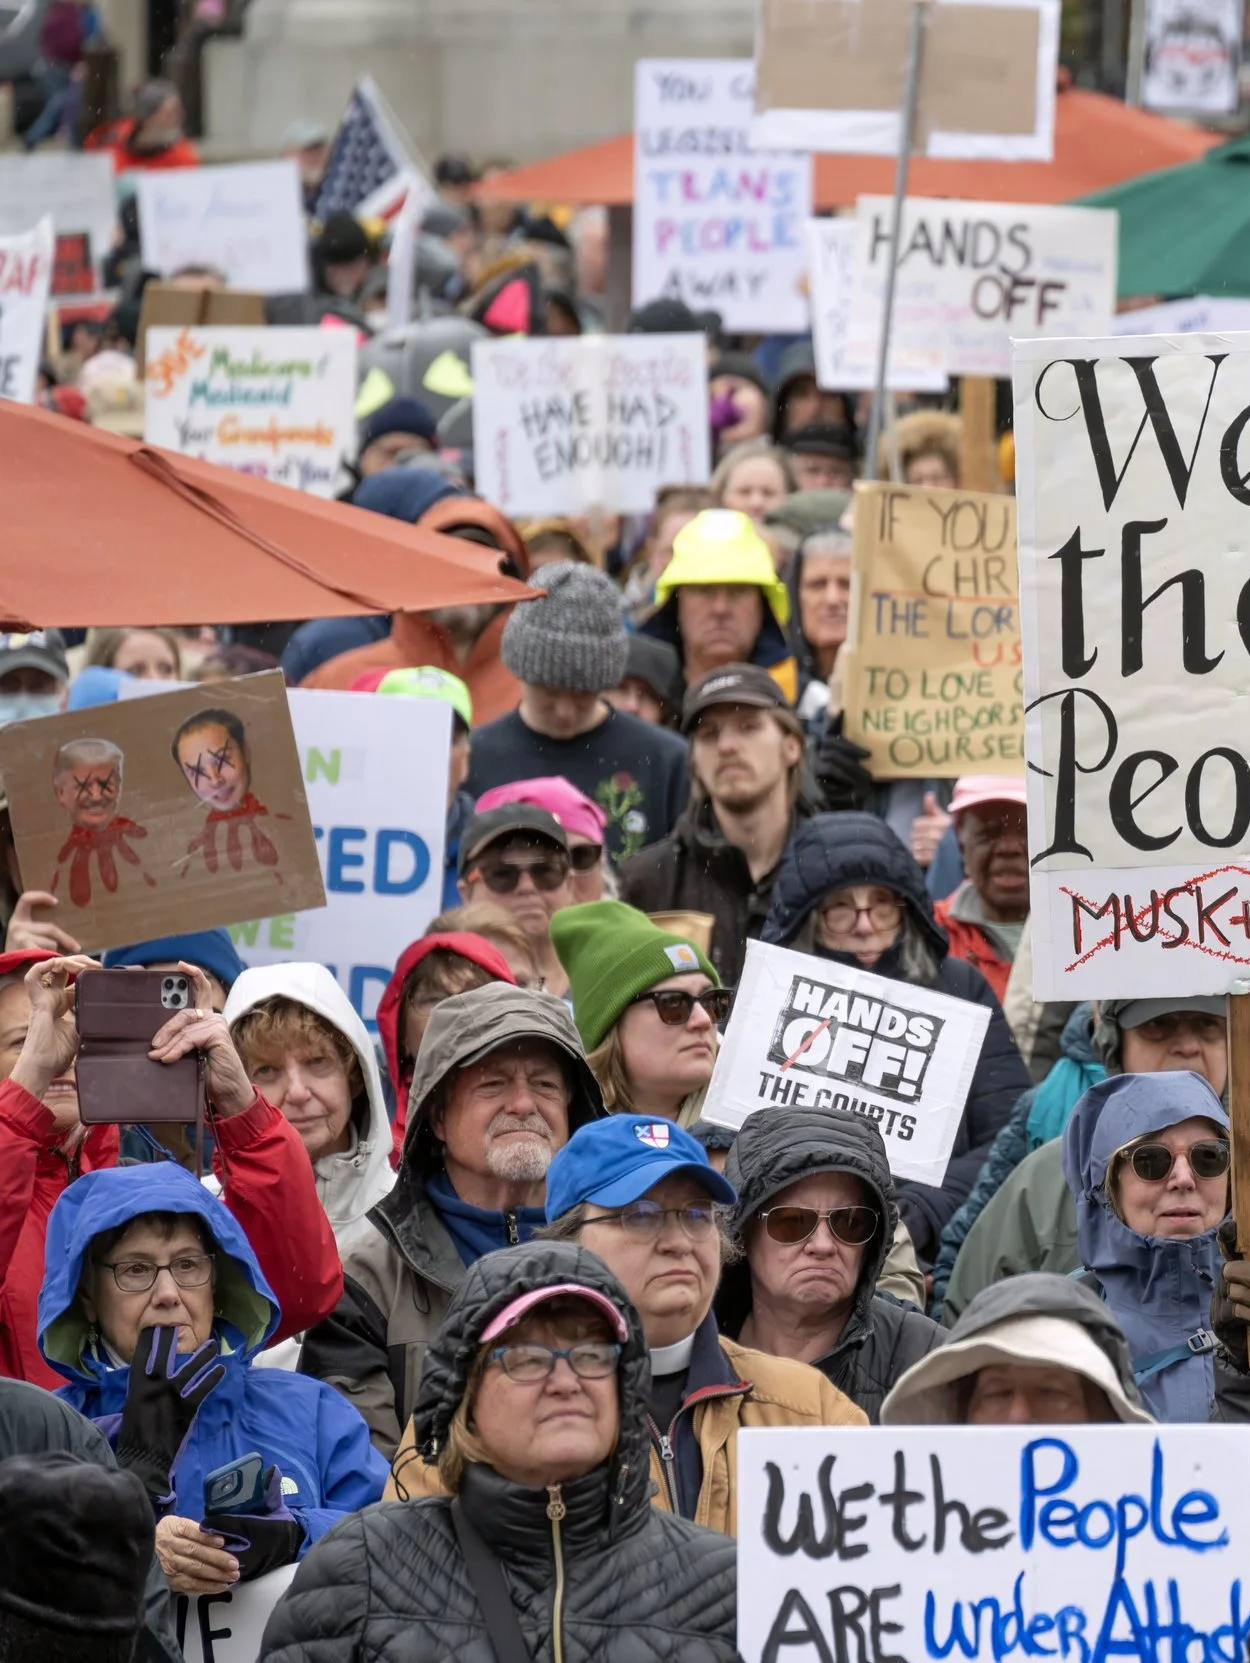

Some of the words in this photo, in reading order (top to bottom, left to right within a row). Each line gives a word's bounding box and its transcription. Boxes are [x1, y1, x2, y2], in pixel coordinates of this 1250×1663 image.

[655, 213, 797, 255] PEOPLE
[870, 214, 1033, 274] HANDS
[662, 265, 767, 298] AWAY
[970, 274, 1067, 325] OFF
[520, 390, 590, 440] HAVE
[606, 393, 677, 428] HAD
[879, 491, 911, 543] IF
[927, 497, 1009, 553] YOU
[922, 555, 1012, 598] CHR
[872, 592, 931, 638] THE
[865, 665, 909, 701] TO
[921, 669, 994, 702] LOVE
[312, 826, 431, 897] ED
[791, 981, 935, 1047] HANDS
[758, 1071, 810, 1106] THE
[762, 1454, 875, 1561] WE
[879, 1450, 1016, 1555] the
[1019, 1437, 1230, 1578] People
[761, 1582, 906, 1663] ARE
